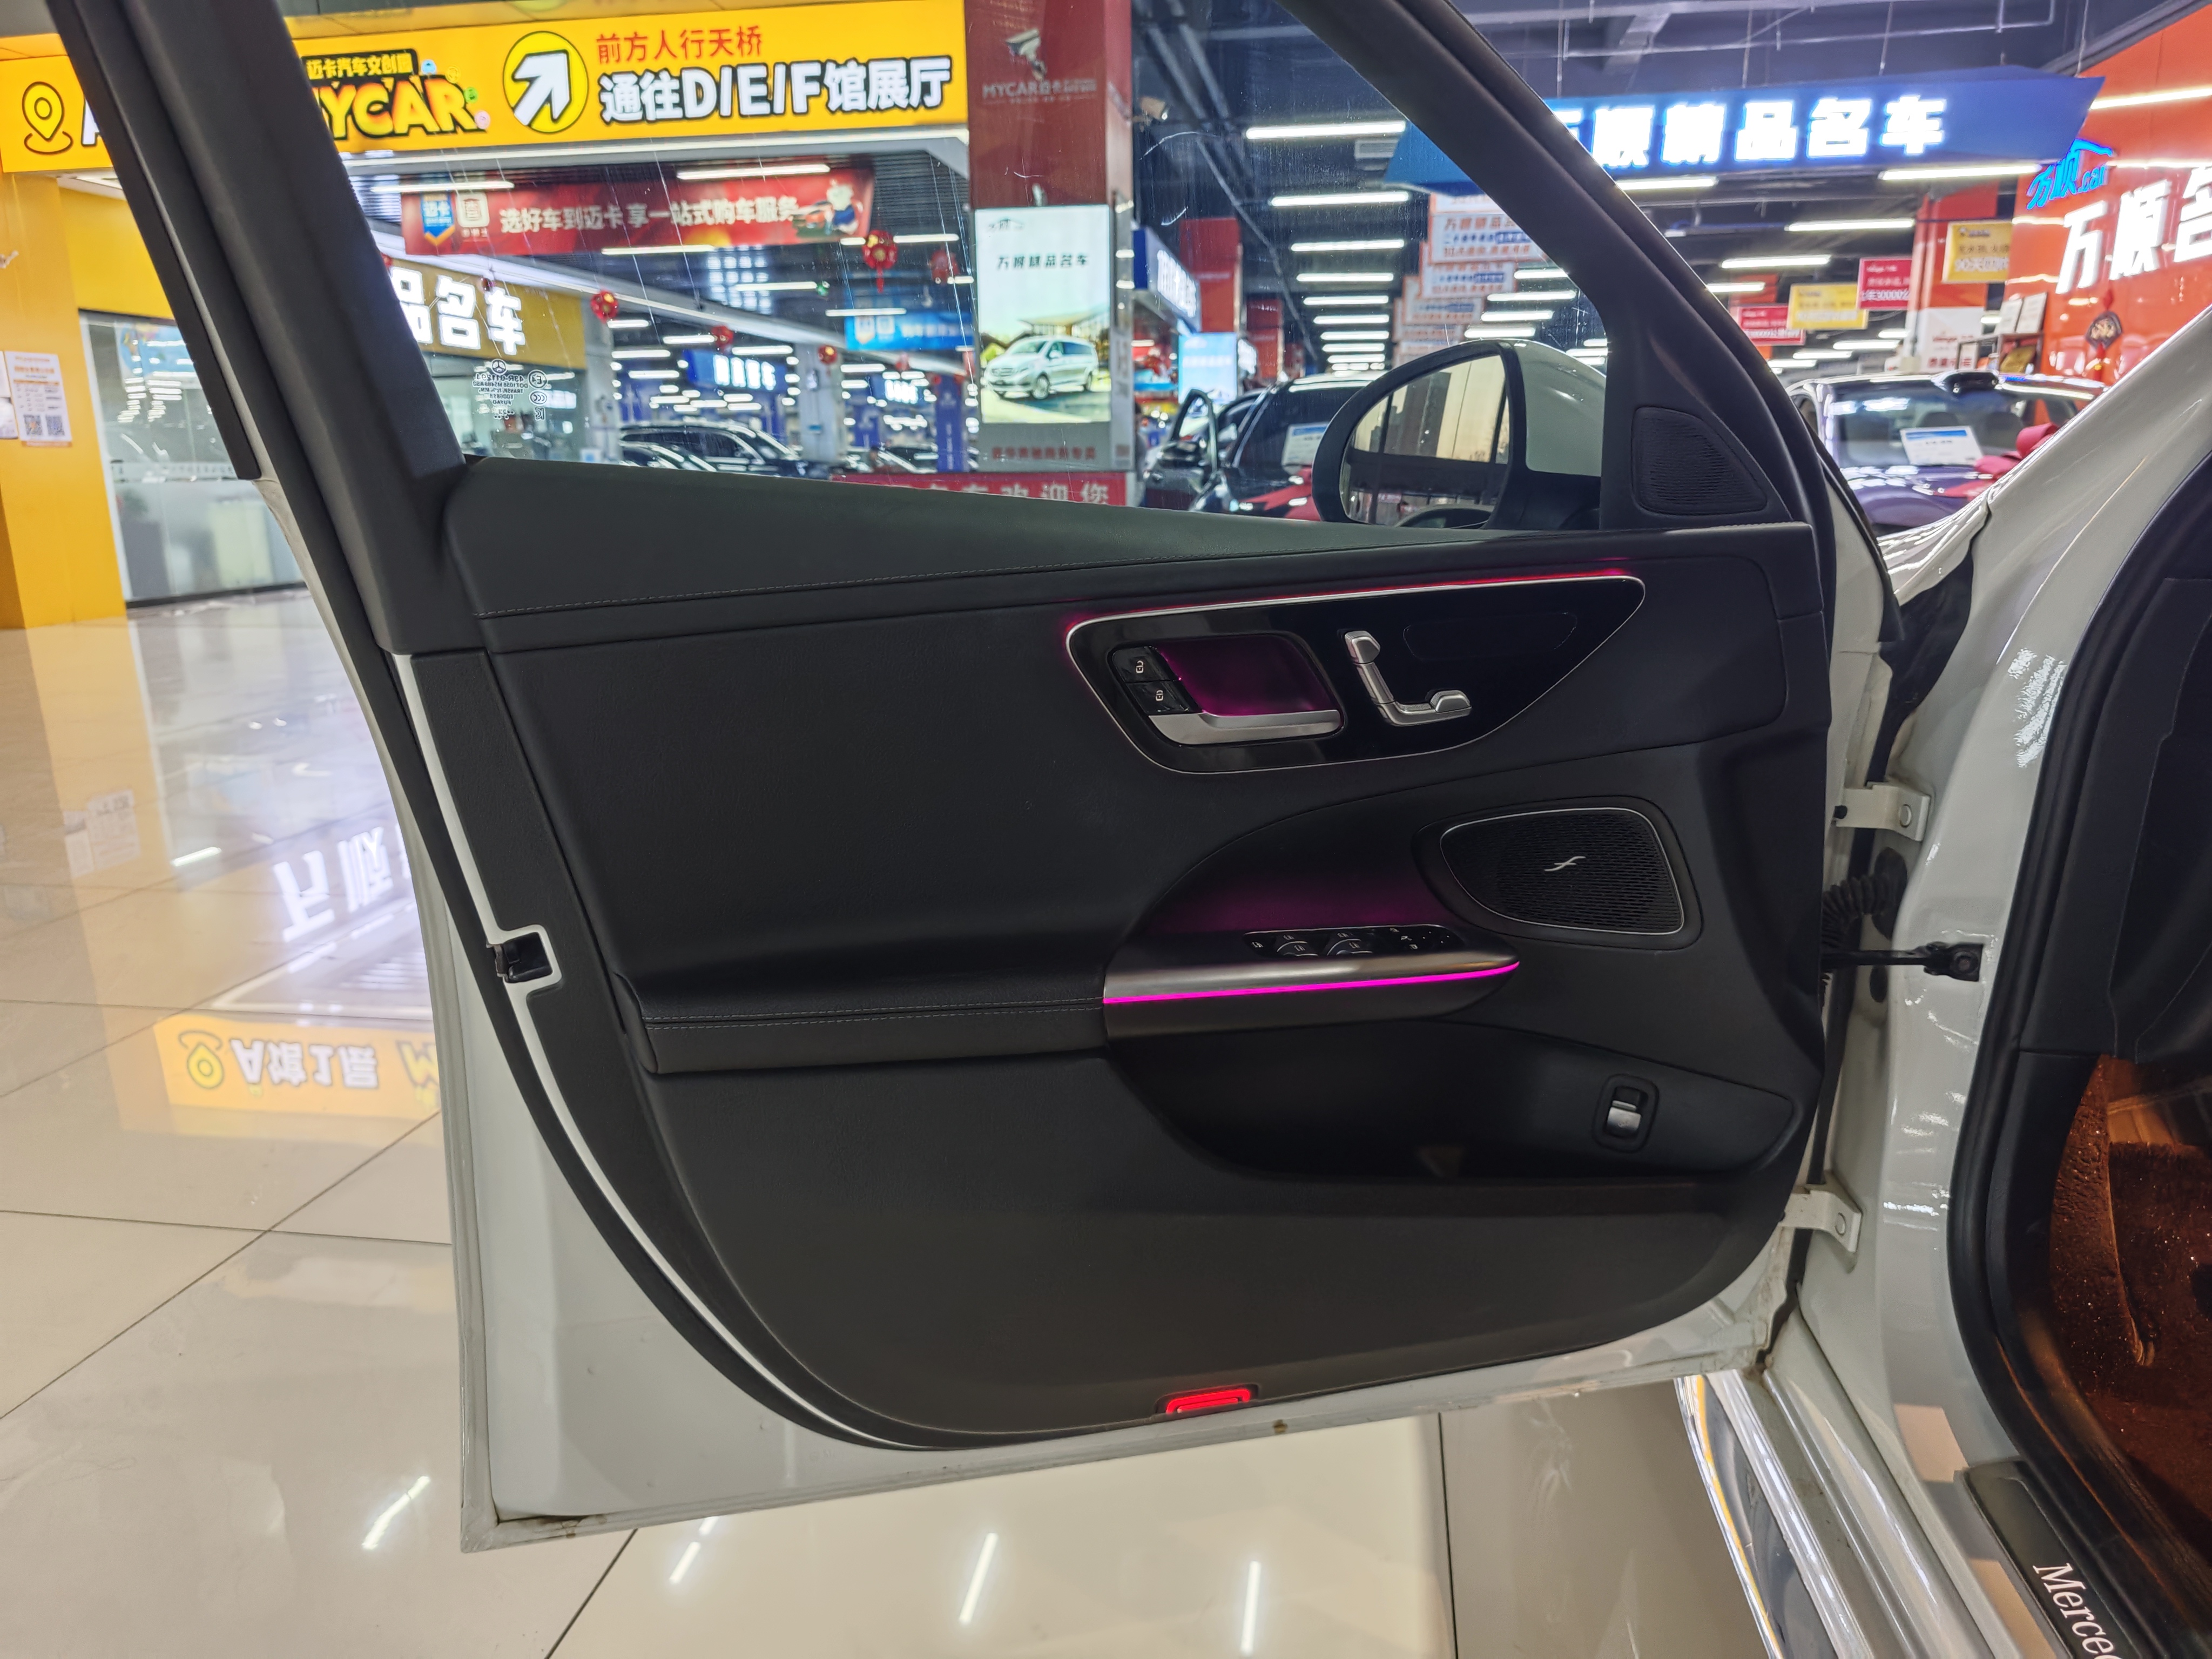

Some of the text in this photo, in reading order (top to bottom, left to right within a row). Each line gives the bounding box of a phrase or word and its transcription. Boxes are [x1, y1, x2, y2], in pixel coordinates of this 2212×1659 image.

[596, 25, 762, 64] 前方人行天桥
[313, 79, 479, 139] YCAR
[500, 195, 798, 233] 选好车到迈卡 享一站式购车服务
[391, 266, 526, 355] 品名车
[2033, 1562, 2122, 1659] Merce
